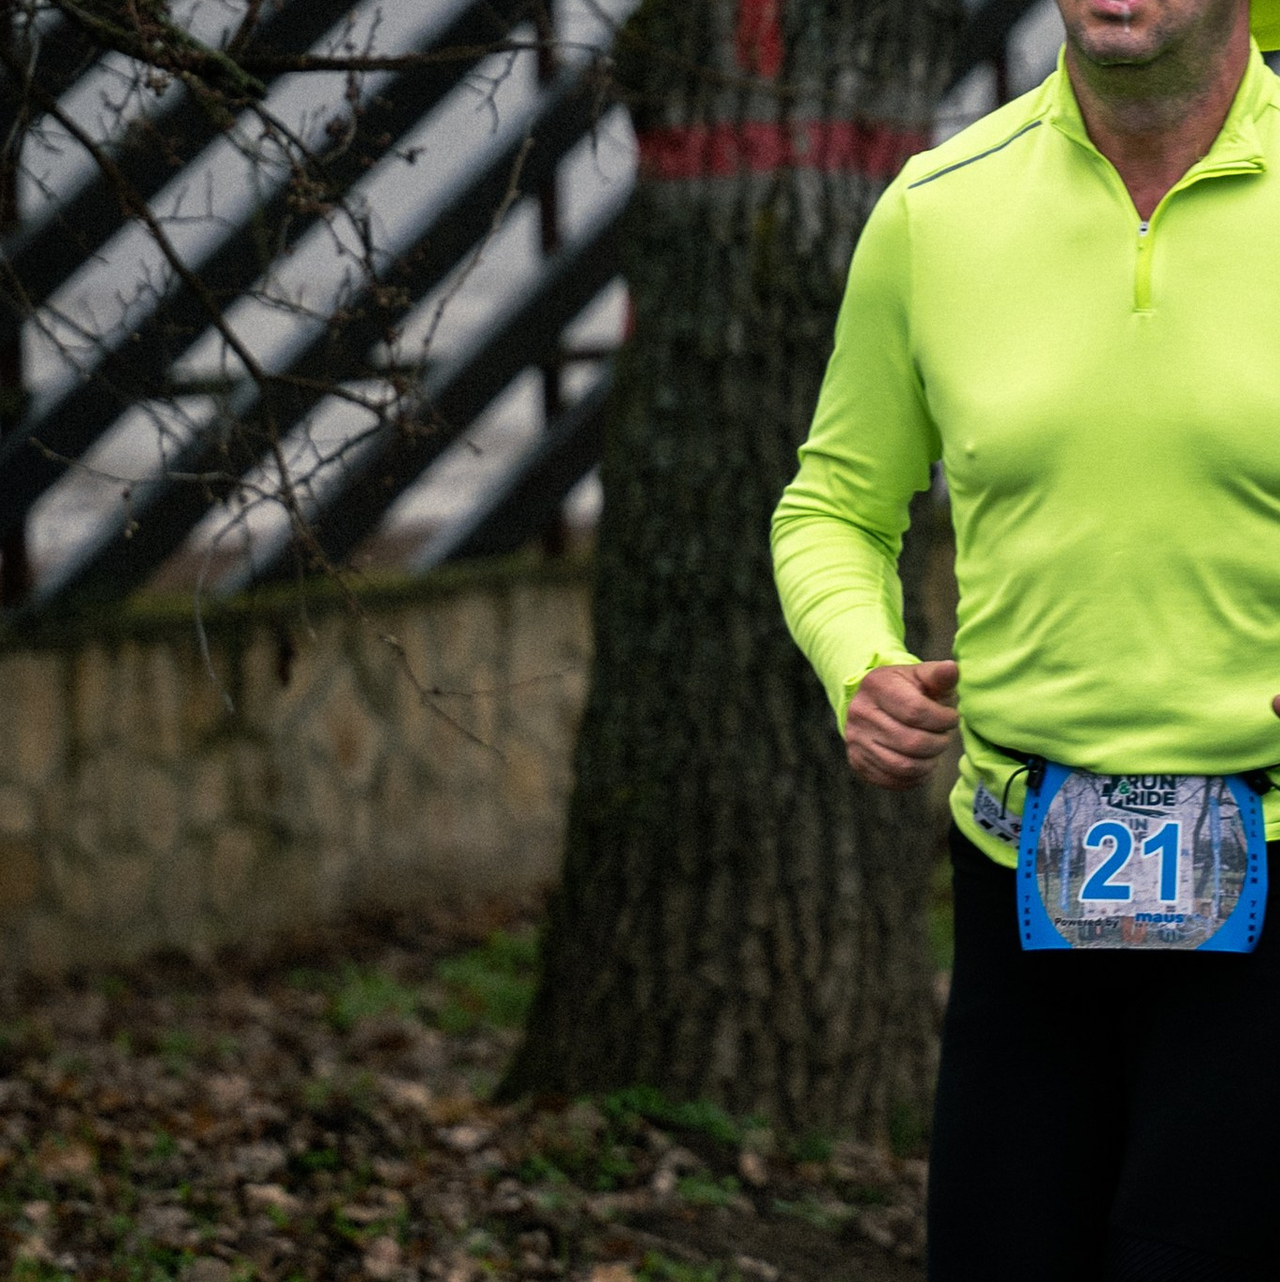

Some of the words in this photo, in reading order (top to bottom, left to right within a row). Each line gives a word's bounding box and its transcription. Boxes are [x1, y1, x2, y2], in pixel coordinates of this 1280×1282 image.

[1128, 775, 1176, 790] RUN
[1125, 791, 1176, 806] RIDE
[1080, 820, 1182, 903] 21
[1054, 917, 1102, 928] Powered
[1105, 918, 1120, 929] by
[1135, 912, 1185, 924] maus
